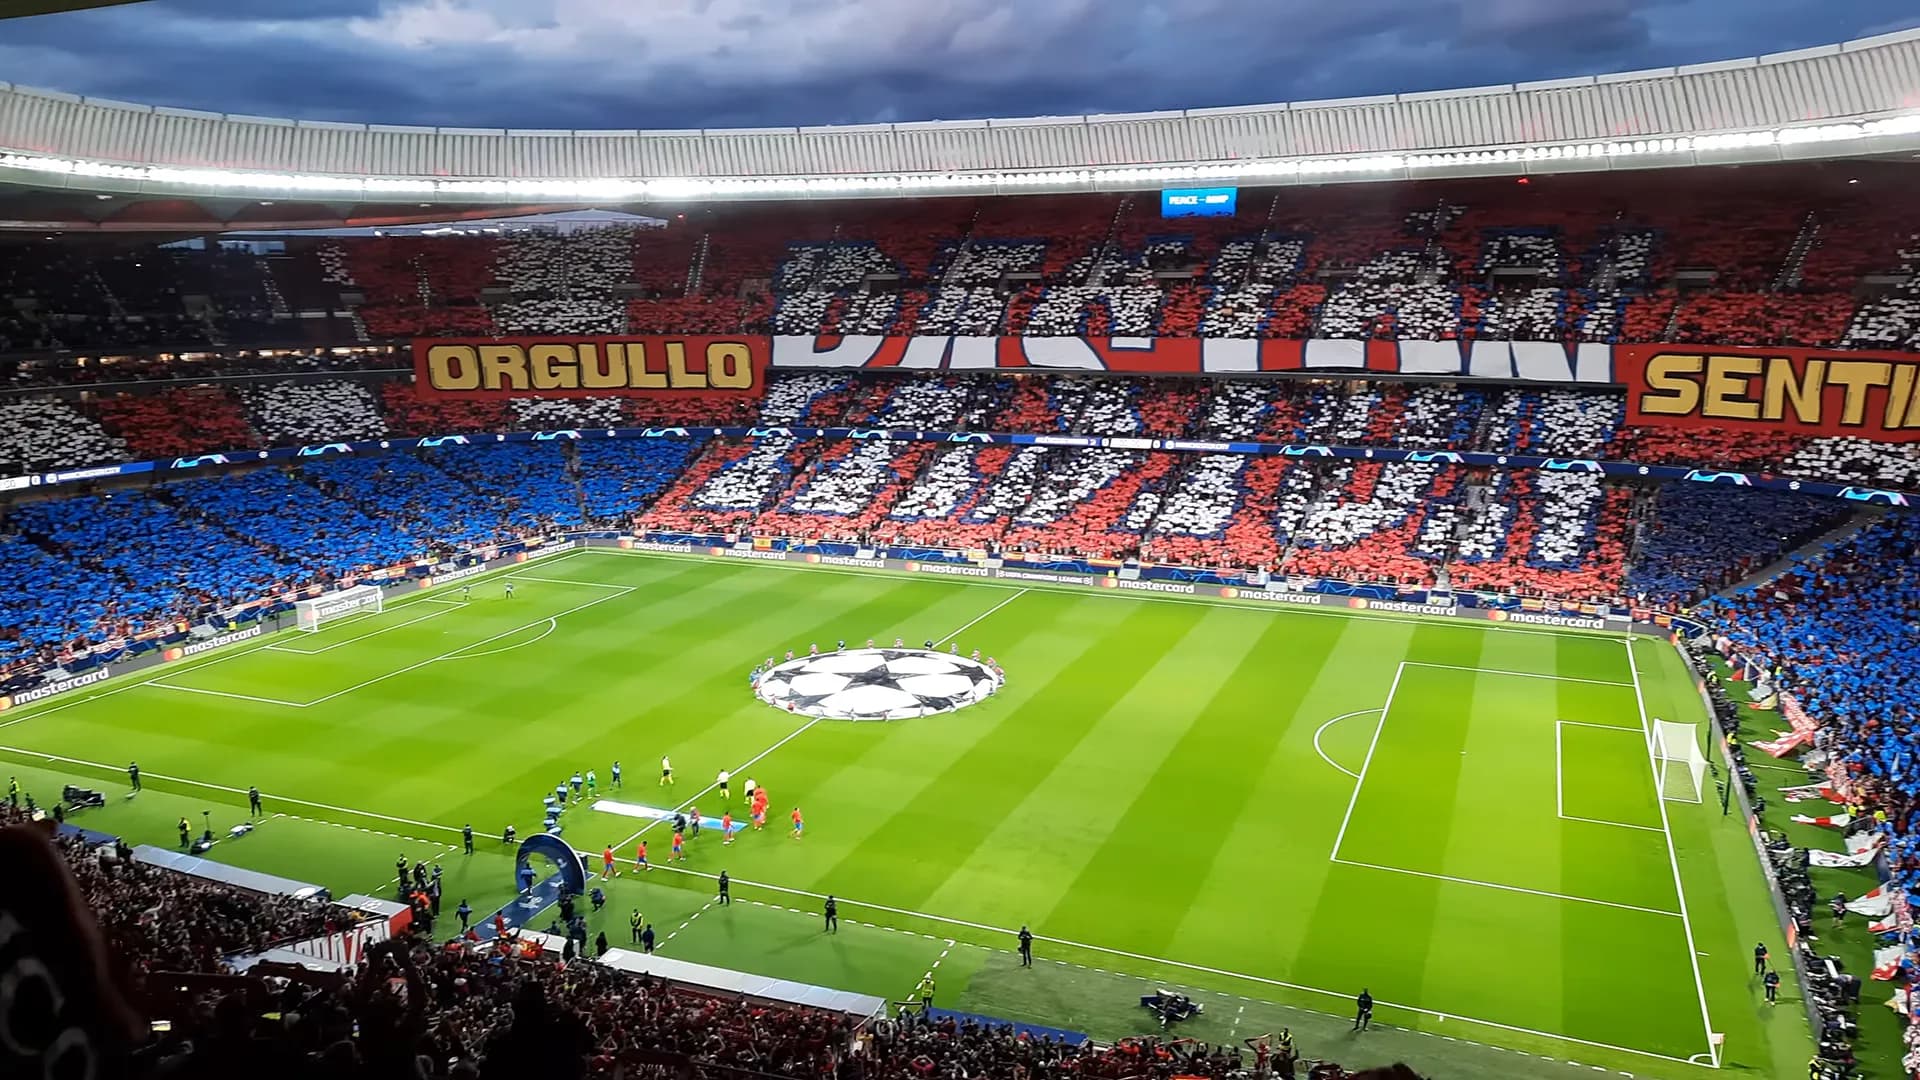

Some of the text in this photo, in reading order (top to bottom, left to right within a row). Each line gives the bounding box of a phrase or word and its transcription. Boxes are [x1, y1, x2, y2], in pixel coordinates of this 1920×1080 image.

[427, 342, 753, 390] ORGULLO
[633, 542, 691, 553] mastercard
[725, 549, 786, 560] mastercard
[821, 556, 885, 568] mastercard
[432, 562, 486, 585] mastercard
[921, 564, 988, 576] mastercard
[1119, 580, 1195, 593] mastercard
[1240, 590, 1321, 604] mastercard
[1369, 600, 1457, 615] mastercard
[1510, 613, 1604, 629] mastercard
[183, 625, 261, 655] mastercard
[14, 667, 109, 705] mastercard
